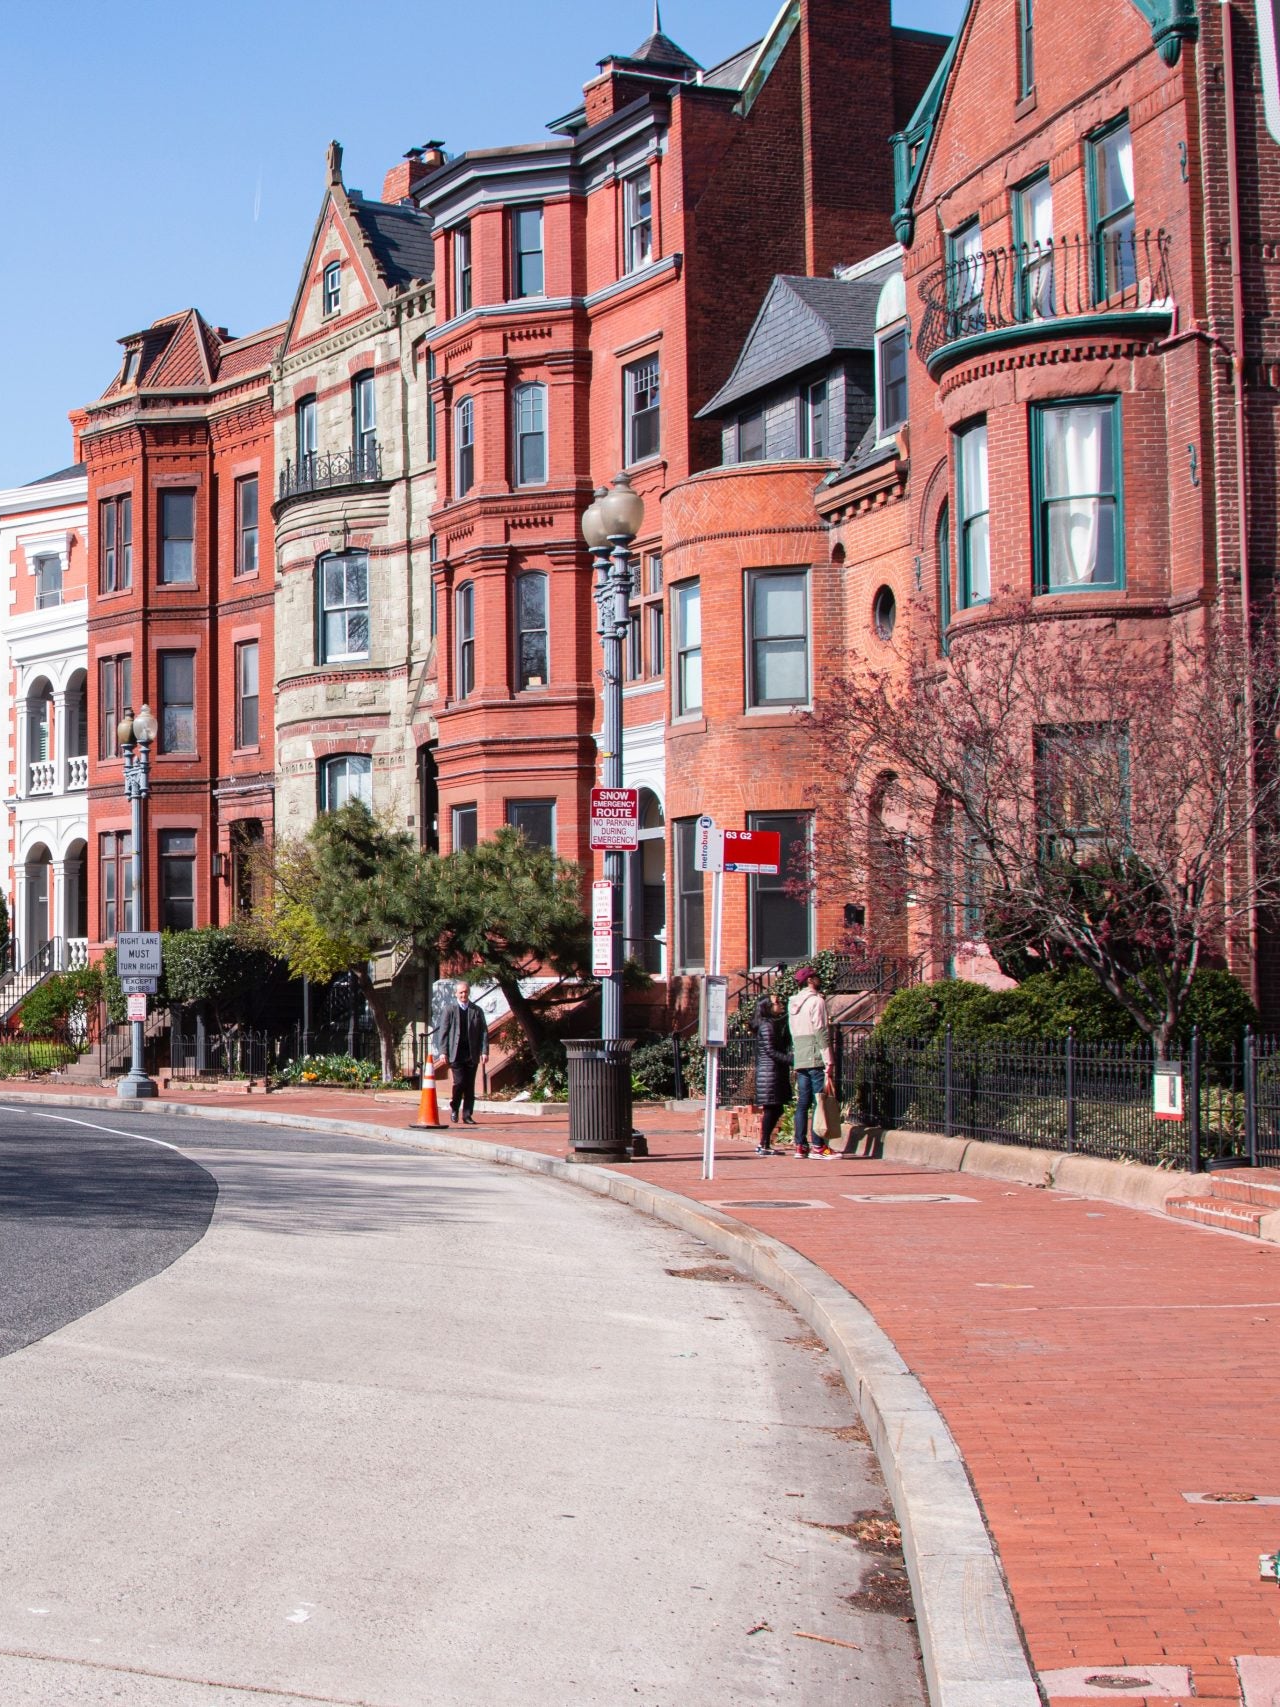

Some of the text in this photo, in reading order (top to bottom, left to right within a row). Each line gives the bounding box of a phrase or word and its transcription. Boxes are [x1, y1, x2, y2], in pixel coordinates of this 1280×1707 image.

[600, 792, 629, 800] SNOW
[596, 808, 632, 817] ROUTE
[740, 832, 752, 840] G2
[129, 950, 150, 958] MUST
